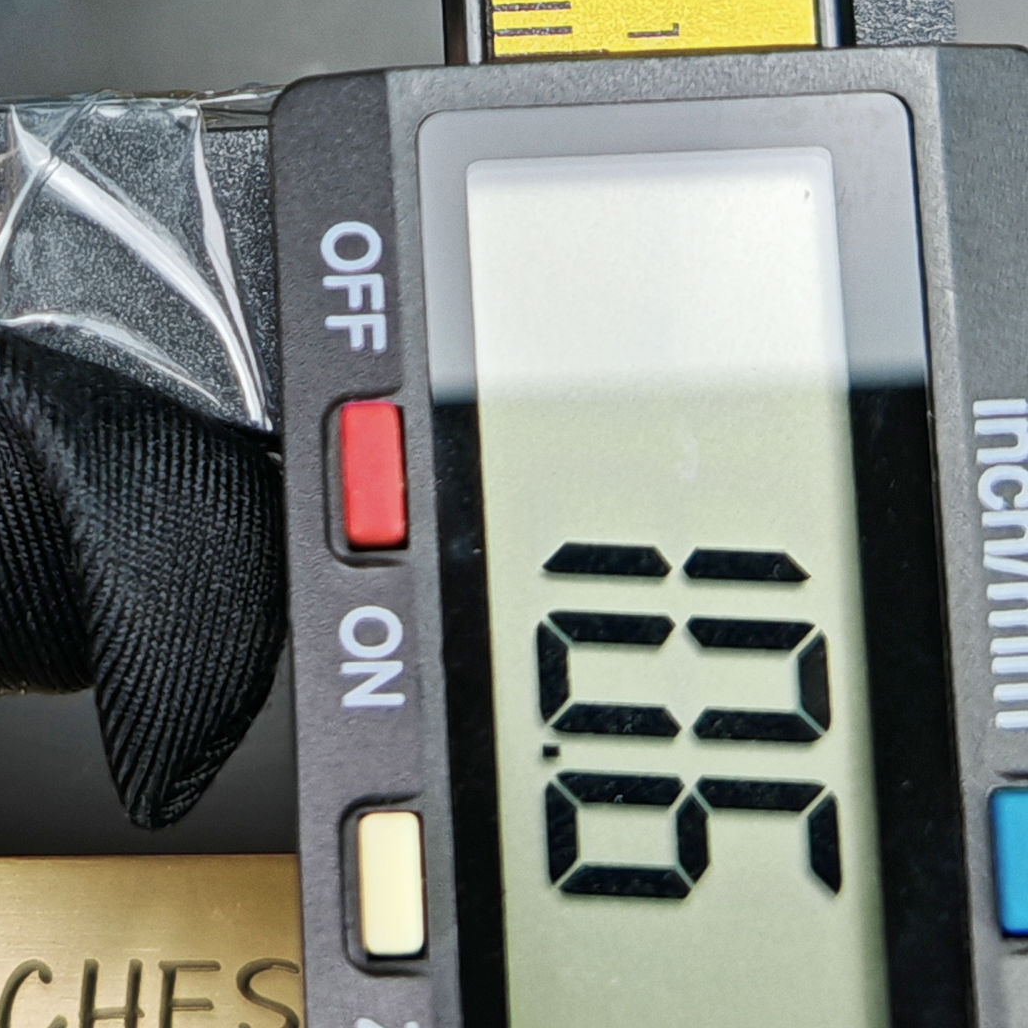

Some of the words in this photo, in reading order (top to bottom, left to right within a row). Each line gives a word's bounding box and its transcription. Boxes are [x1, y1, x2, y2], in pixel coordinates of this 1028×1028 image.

[627, 22, 680, 39] 1
[320, 220, 388, 353] OFF
[338, 605, 407, 709] ON
[536, 541, 842, 898] 10.6
